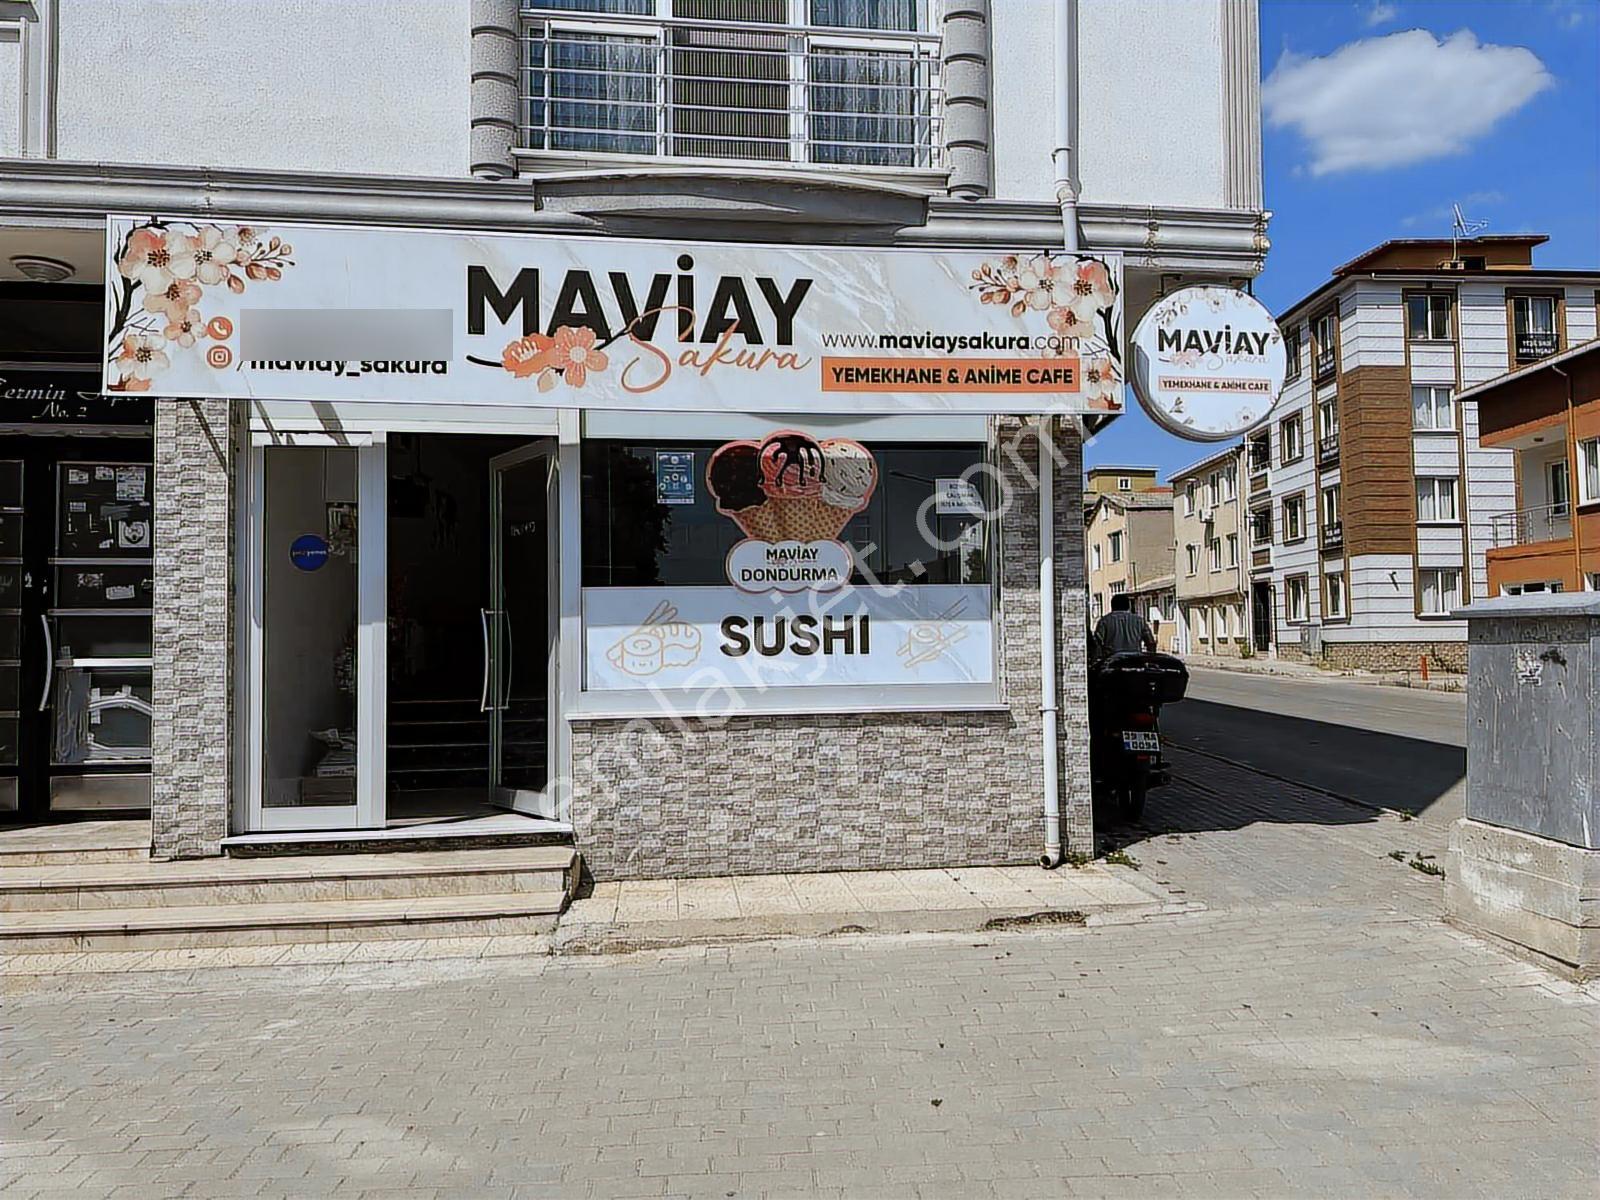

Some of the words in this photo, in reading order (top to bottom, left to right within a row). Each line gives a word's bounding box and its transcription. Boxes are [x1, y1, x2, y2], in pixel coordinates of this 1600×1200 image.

[467, 253, 814, 347] MAVİAY
[621, 305, 815, 394] Sakura
[821, 331, 1081, 354] www.maviaysakura.com
[831, 366, 942, 384] YEMEKHANE
[946, 367, 960, 384] &
[964, 364, 1022, 385] ANİME
[1022, 368, 1073, 385] CAFE
[1162, 380, 1211, 389] YEMEKHANE
[1247, 382, 1269, 391] CAFE
[741, 567, 839, 582] DONDURMA
[719, 613, 870, 658] SUSHI
